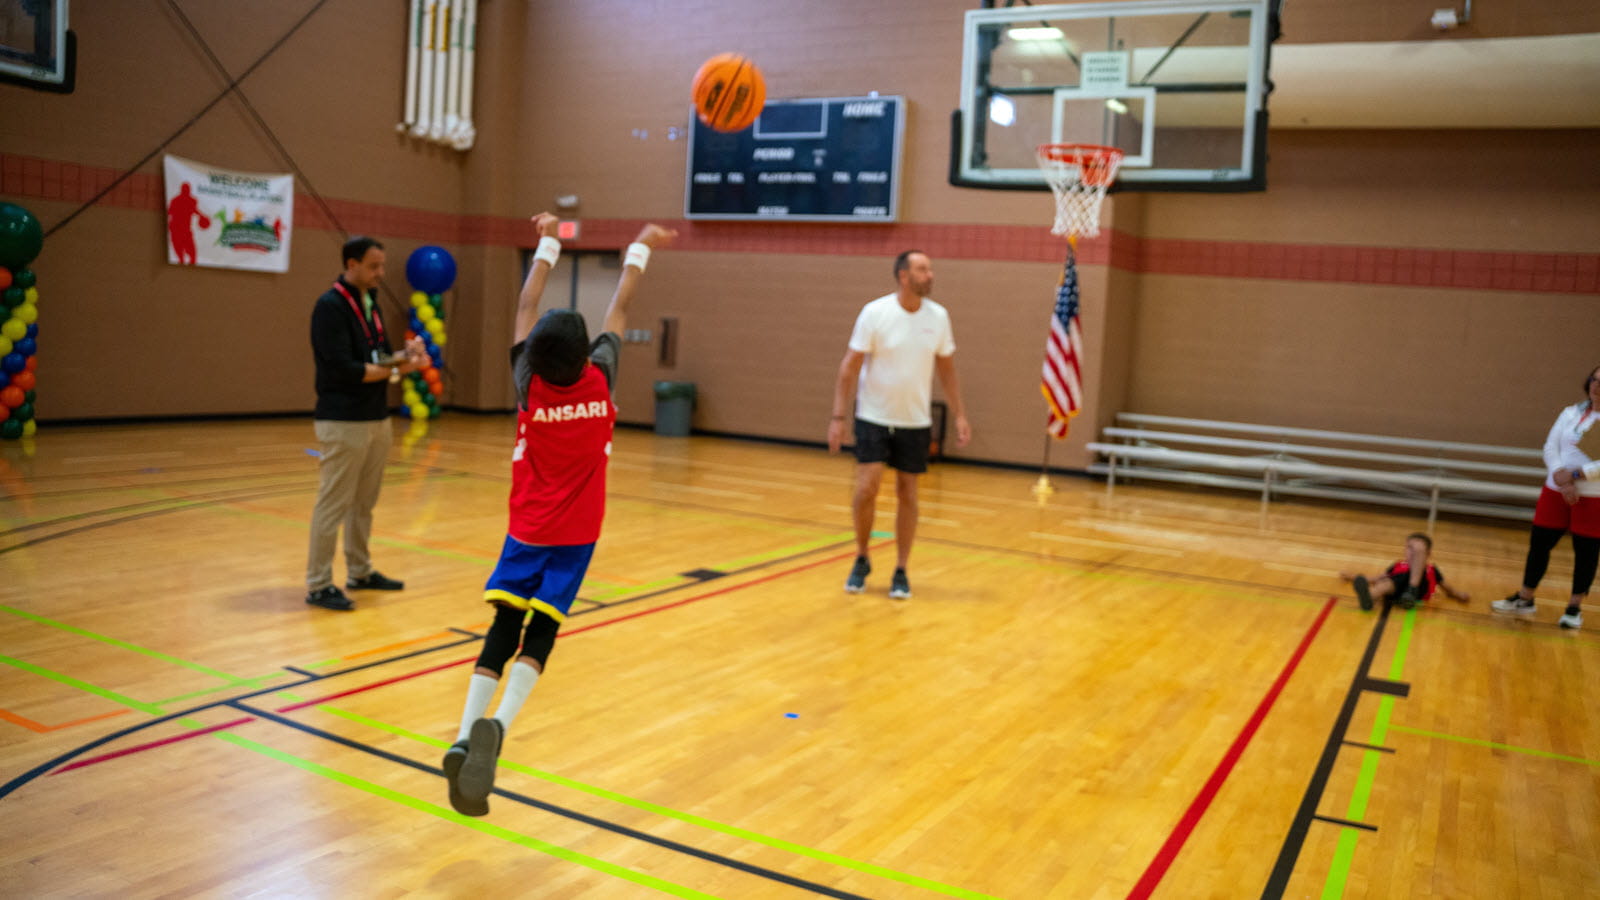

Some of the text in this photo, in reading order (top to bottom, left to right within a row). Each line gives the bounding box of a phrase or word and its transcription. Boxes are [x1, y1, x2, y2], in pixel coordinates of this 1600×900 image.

[843, 102, 886, 117] HOME
[753, 147, 795, 160] PERIOD
[208, 171, 270, 191] WELCOME
[532, 400, 608, 422] ANSARI
